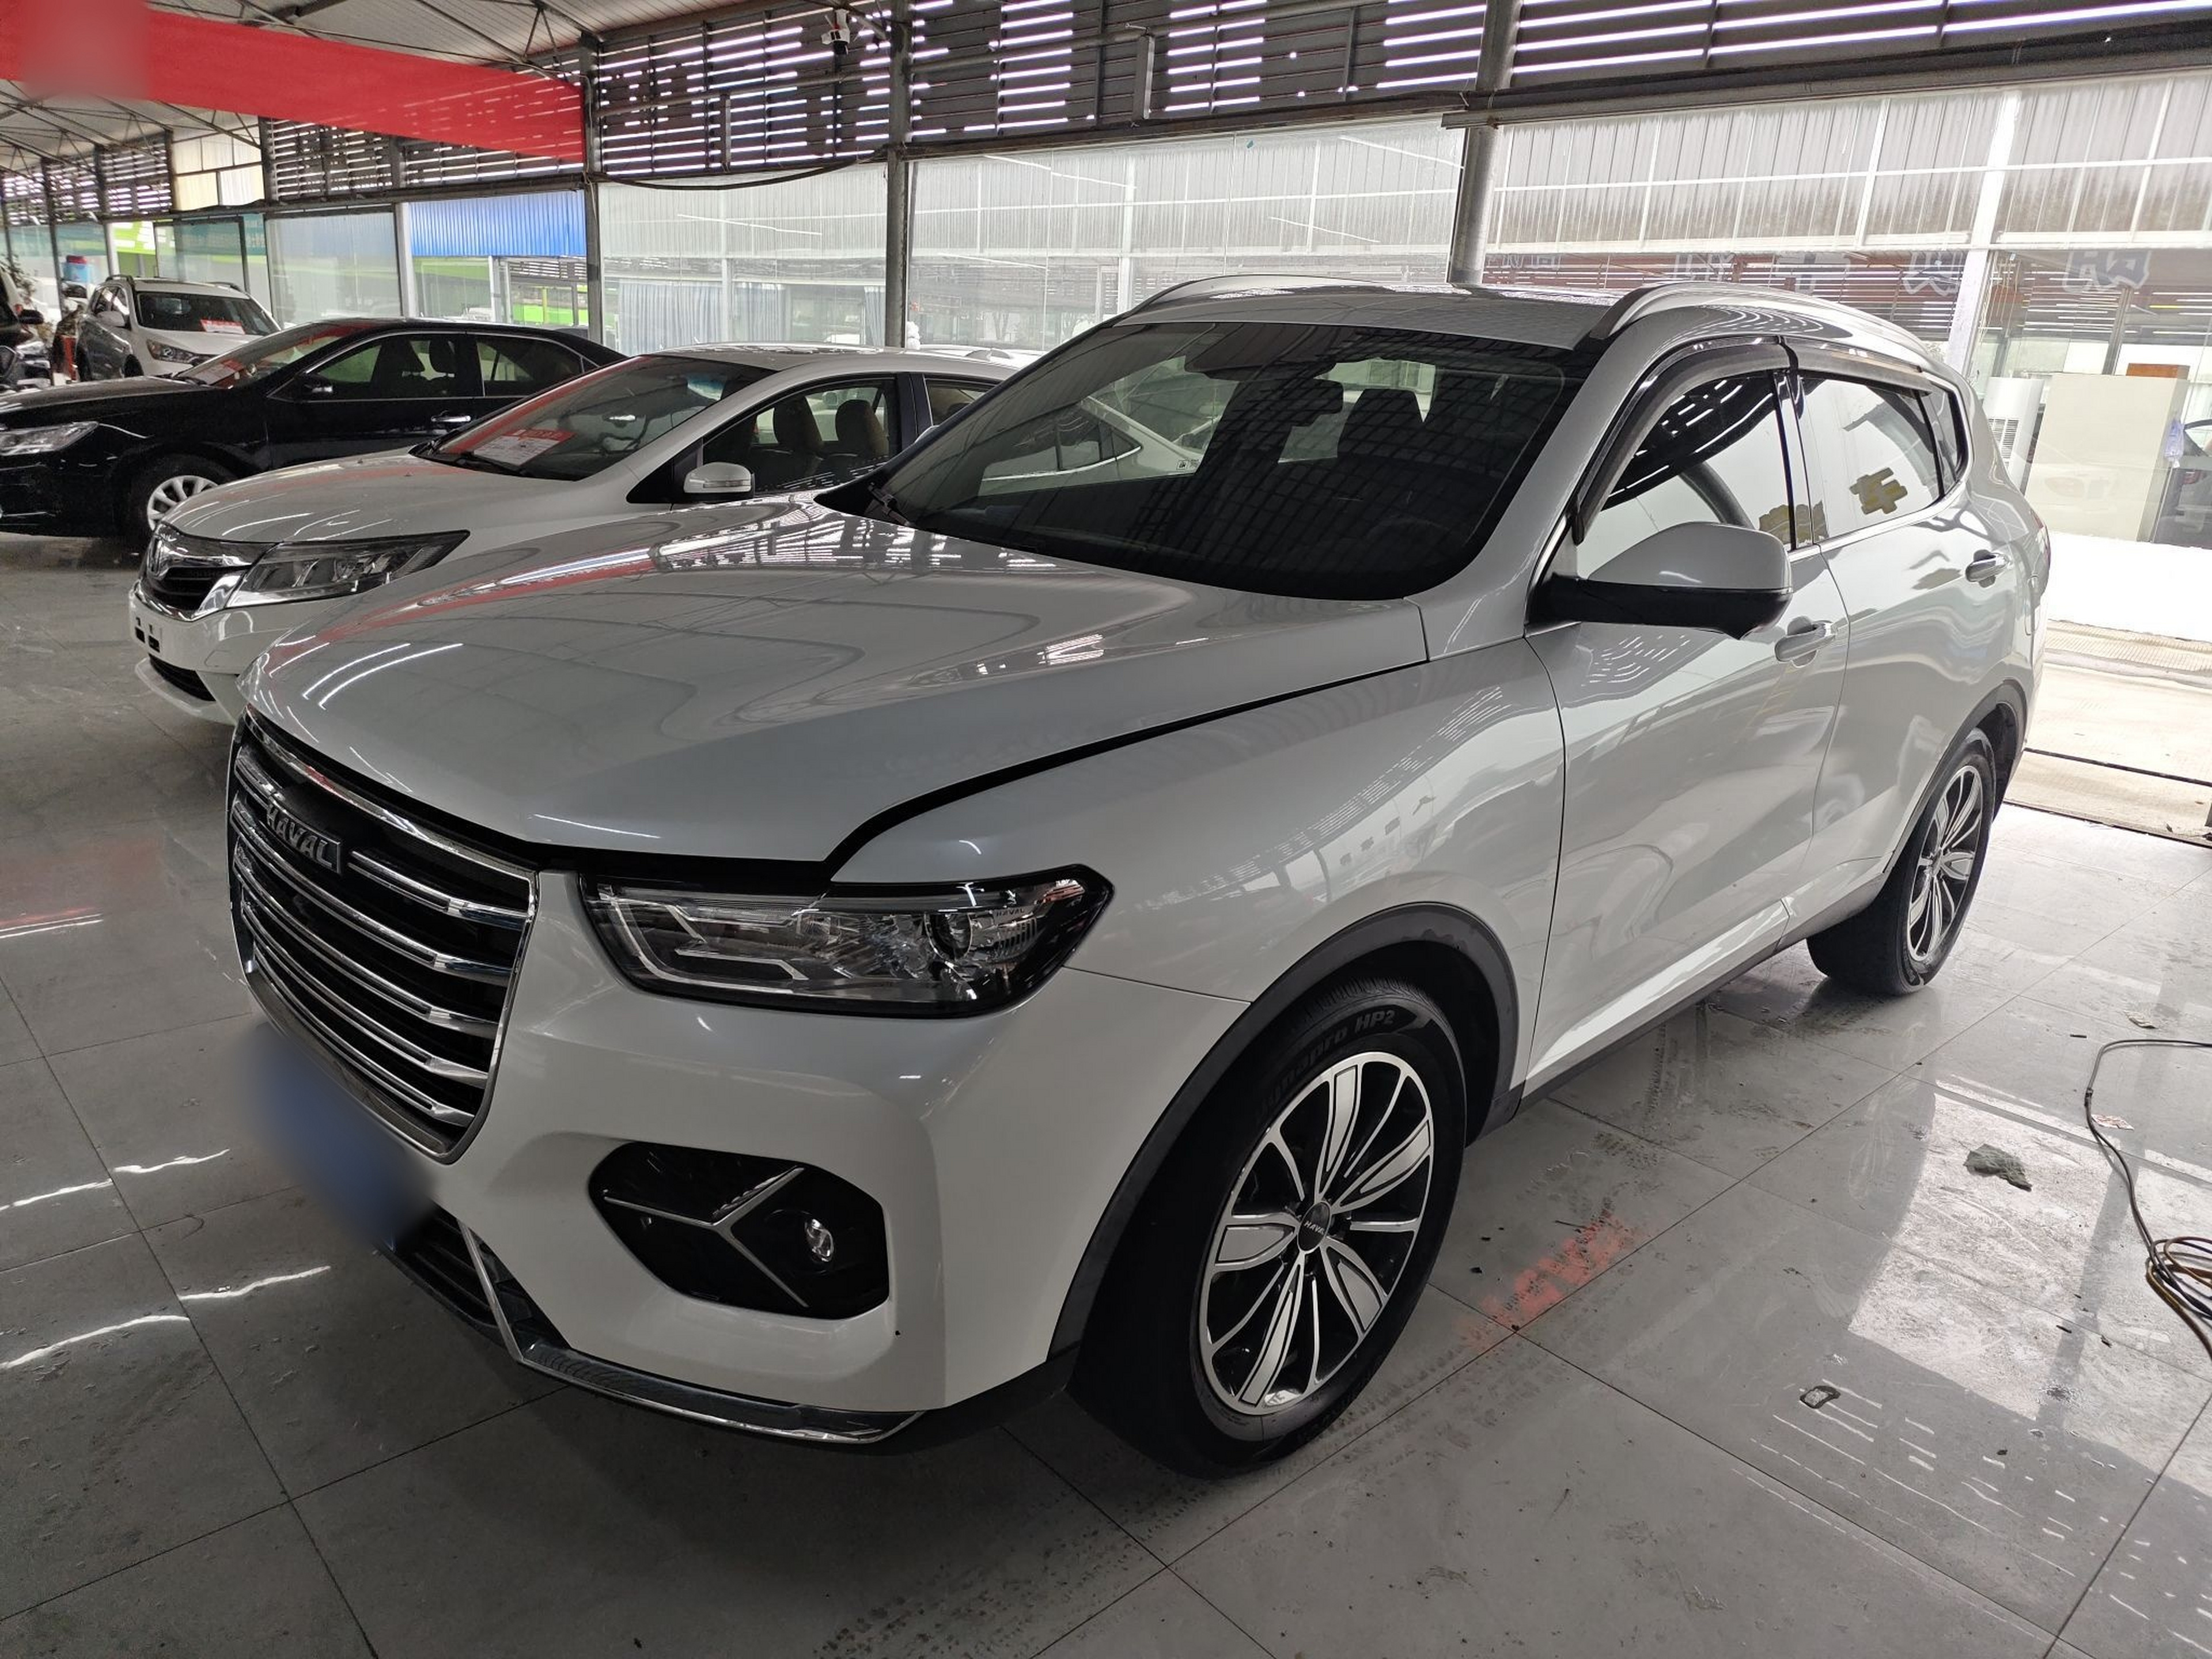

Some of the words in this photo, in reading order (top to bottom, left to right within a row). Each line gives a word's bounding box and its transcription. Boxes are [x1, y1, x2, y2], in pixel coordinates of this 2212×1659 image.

[266, 804, 332, 868] HAVAL
[1355, 1010, 1395, 1033] HP2
[1304, 1221, 1325, 1236] HAVA
